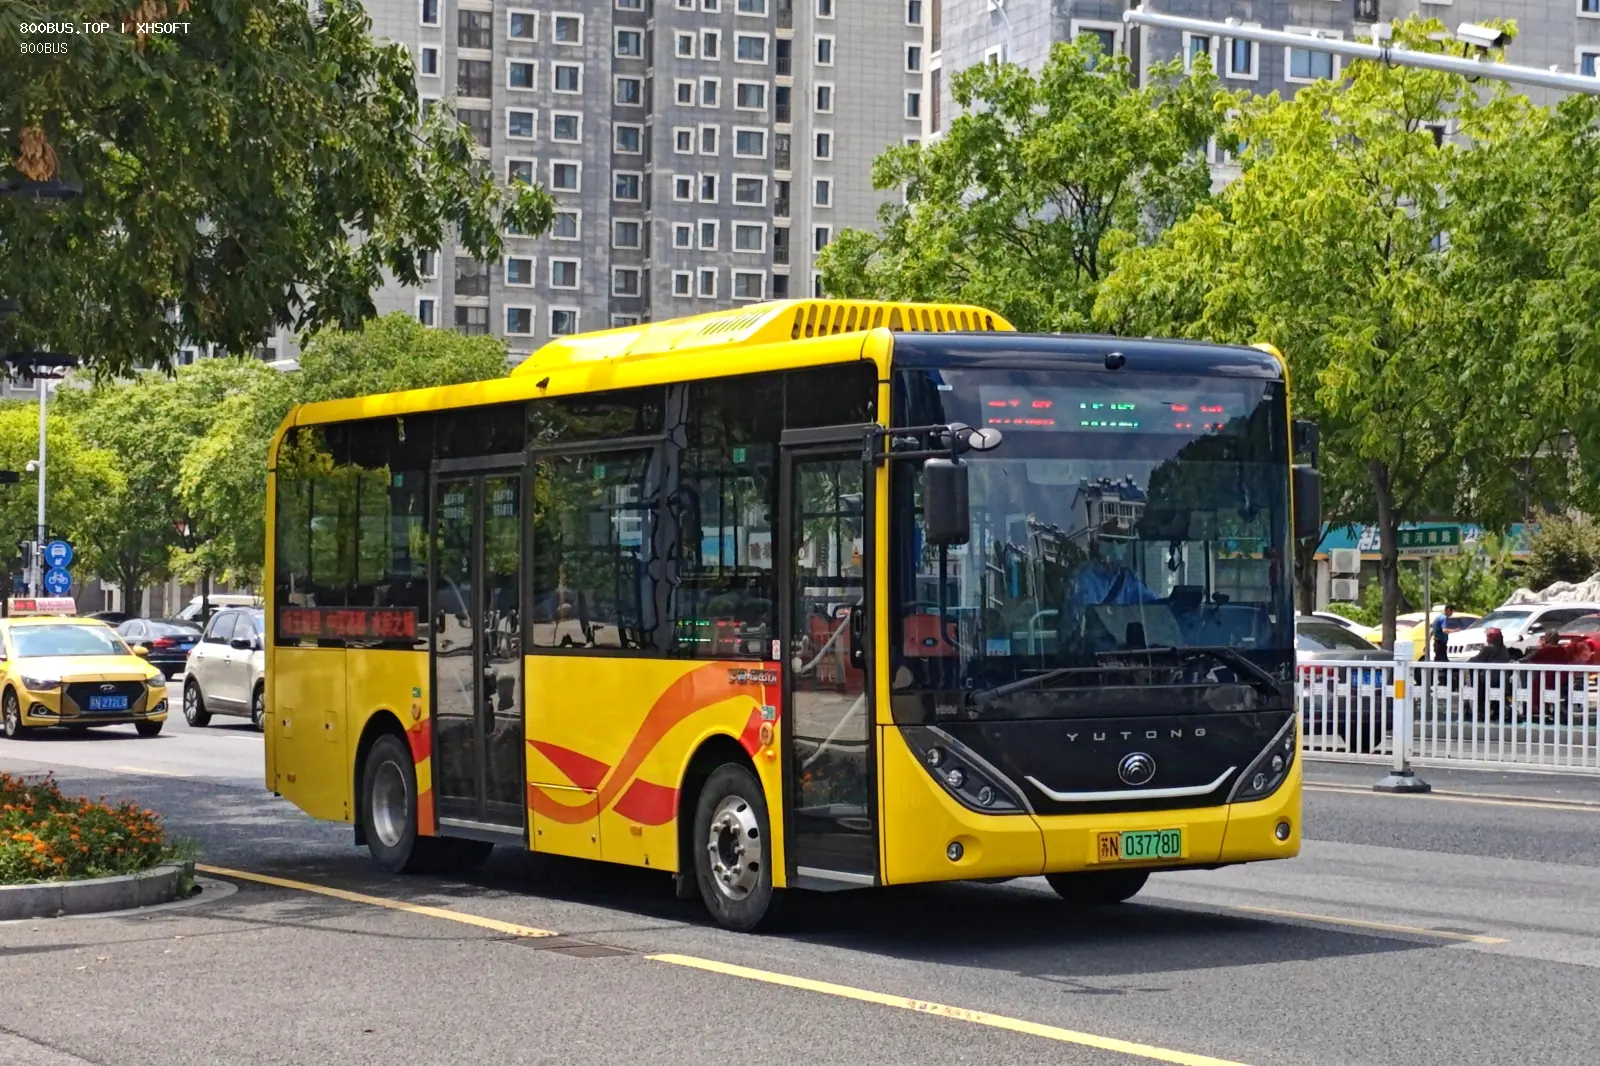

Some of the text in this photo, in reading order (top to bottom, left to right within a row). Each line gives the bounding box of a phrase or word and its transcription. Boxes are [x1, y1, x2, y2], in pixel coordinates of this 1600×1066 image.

[1401, 530, 1451, 545] 黄河南路
[1066, 728, 1206, 742] YUTONG
[1101, 833, 1180, 857] 苏N 03778D
